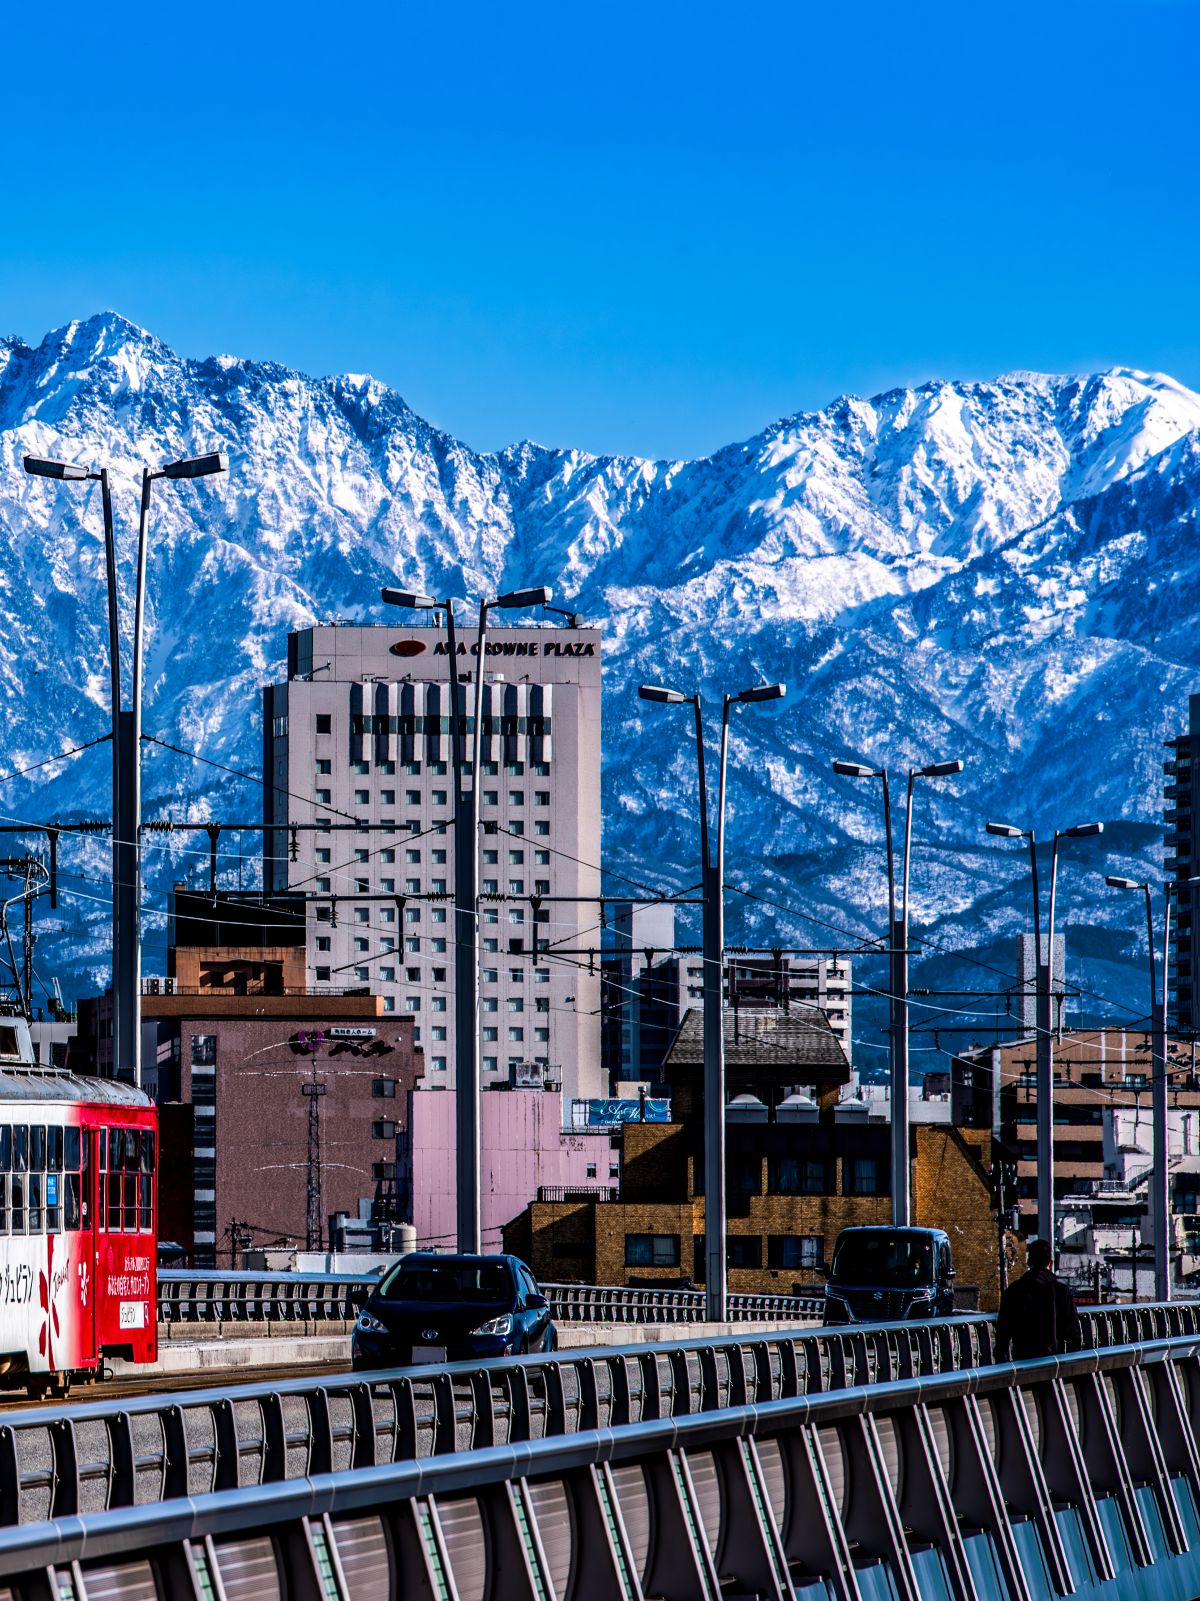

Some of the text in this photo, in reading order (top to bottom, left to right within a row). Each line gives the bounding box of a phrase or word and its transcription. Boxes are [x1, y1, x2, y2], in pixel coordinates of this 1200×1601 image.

[433, 641, 467, 656] AA
[543, 642, 595, 657] PLAZA
[4, 1263, 34, 1305] ジュビラン
[121, 1306, 136, 1324] ジュビラン
